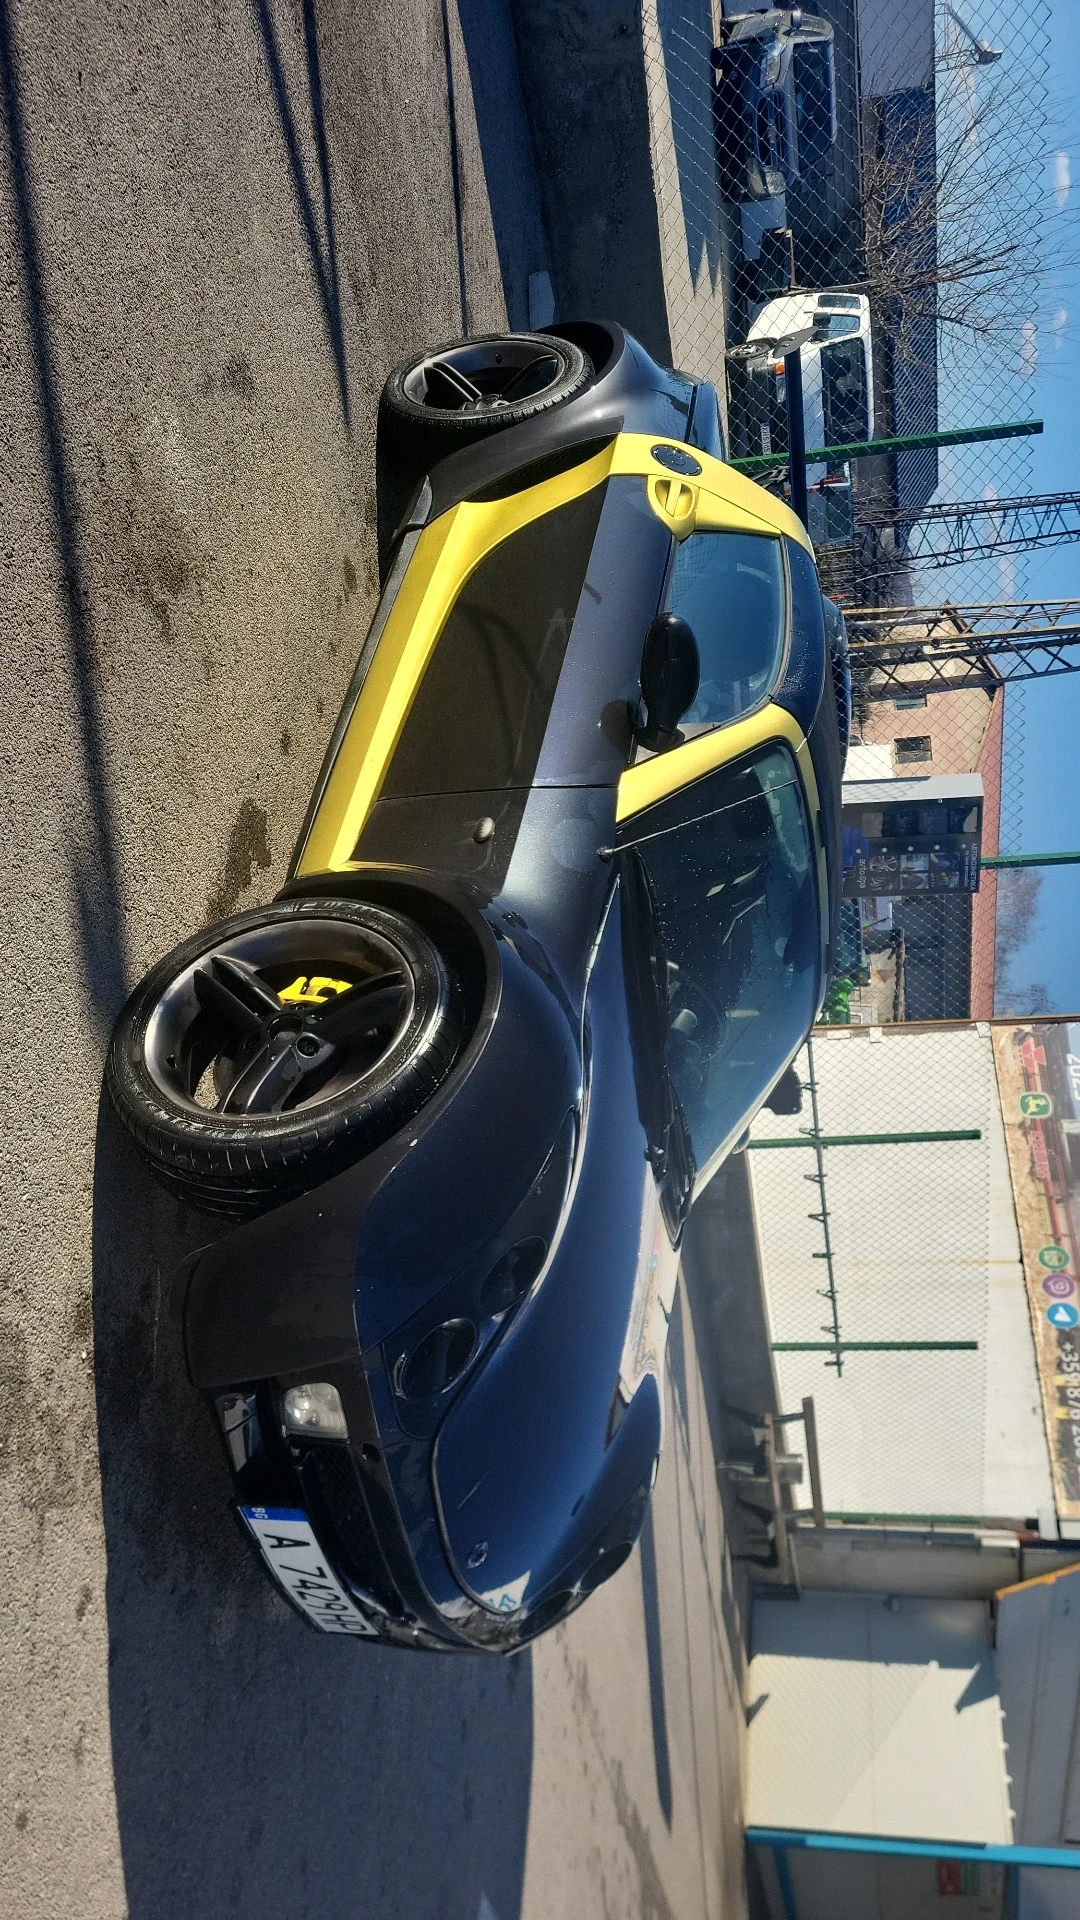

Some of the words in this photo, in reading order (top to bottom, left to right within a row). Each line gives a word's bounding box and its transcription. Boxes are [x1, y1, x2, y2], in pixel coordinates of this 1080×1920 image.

[762, 428, 771, 456] KH5145
[1061, 1341, 1080, 1382] +359
[251, 1507, 268, 1519] BG
[263, 1534, 311, 1548] A
